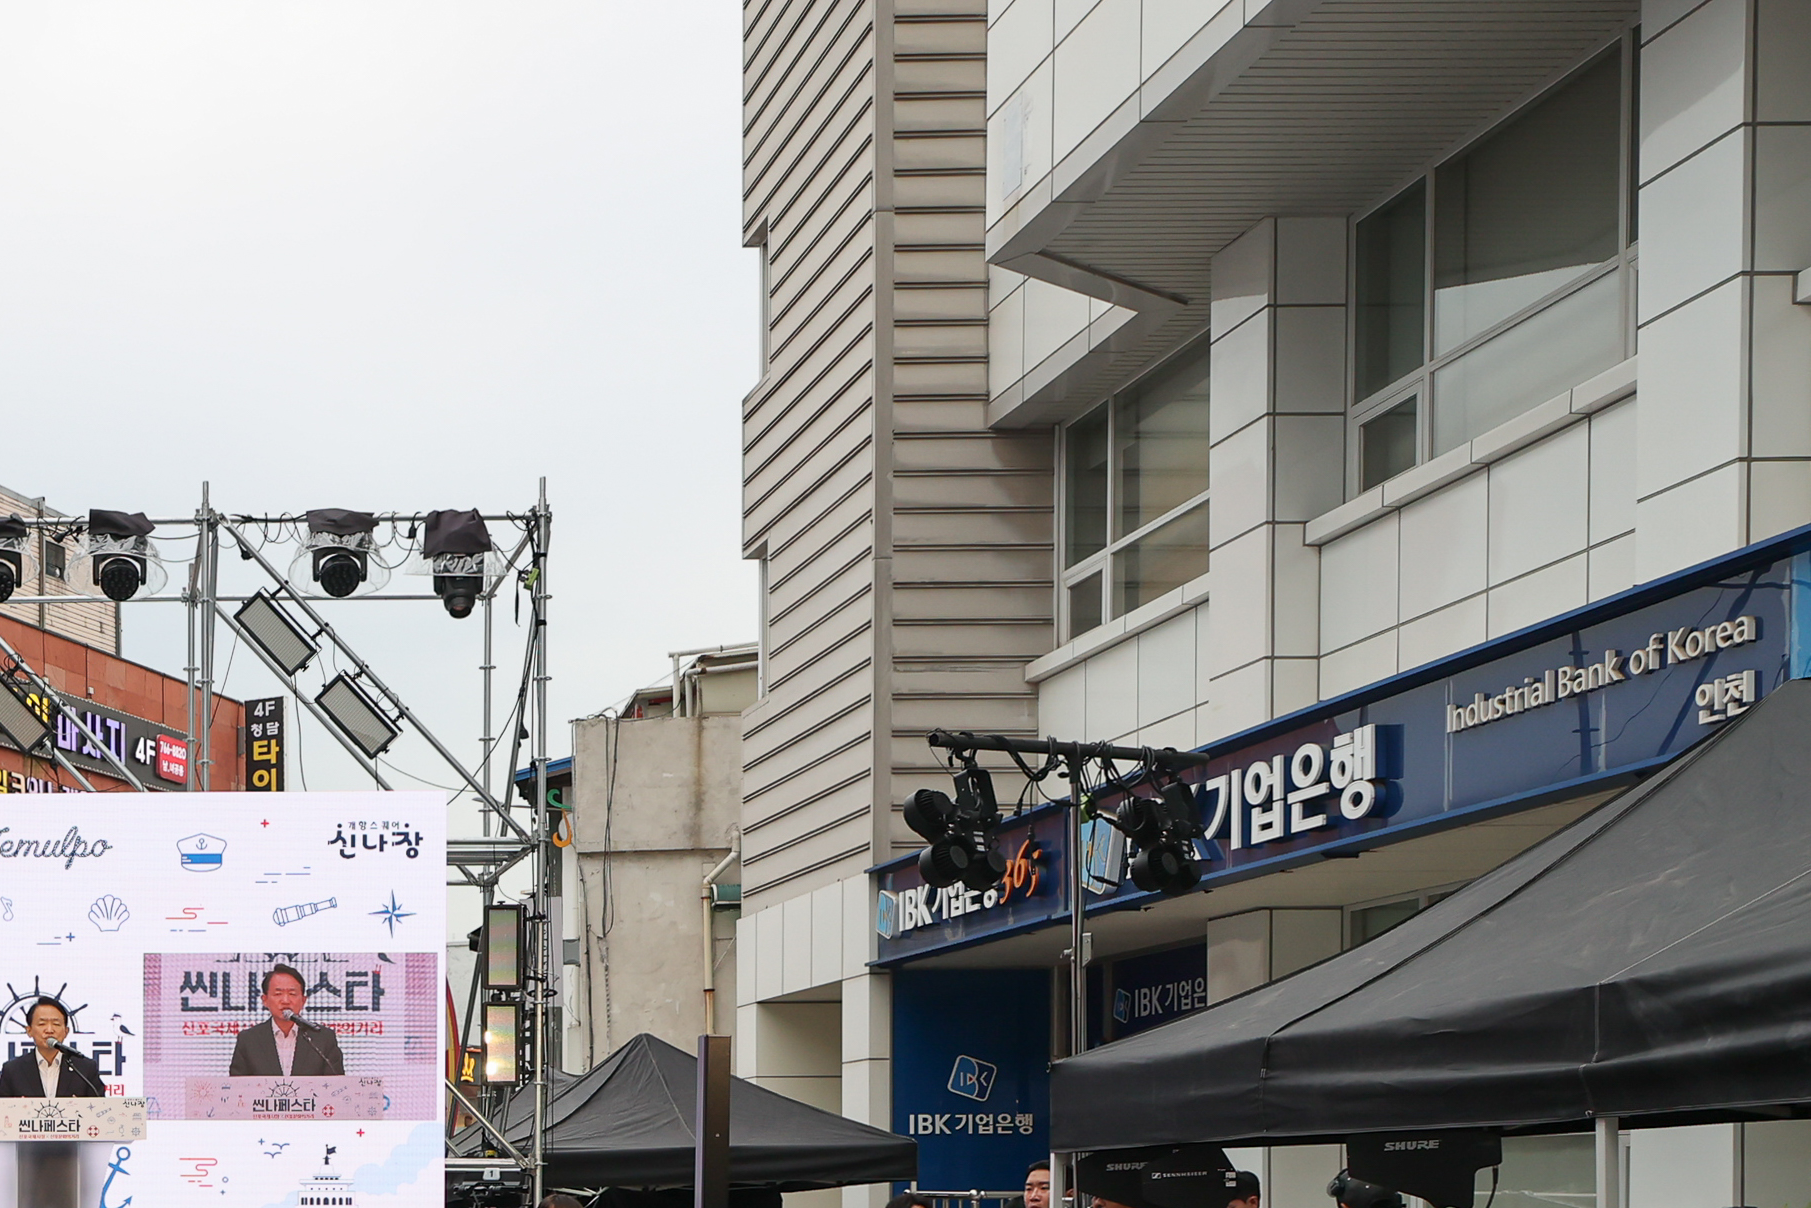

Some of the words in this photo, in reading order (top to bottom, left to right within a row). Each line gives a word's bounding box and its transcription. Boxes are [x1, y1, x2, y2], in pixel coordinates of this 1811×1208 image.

[1446, 668, 1556, 734] Industrial
[1557, 648, 1626, 700] Bank
[1629, 632, 1665, 677] of
[1666, 615, 1756, 665] Korea
[253, 701, 276, 717] 4F
[1694, 669, 1756, 726] 인천
[250, 721, 280, 738] 청담
[135, 736, 156, 765] 4F
[179, 970, 385, 1013] 씬나스타
[18, 1119, 81, 1133] 씬나페스타
[1383, 1139, 1441, 1151] SHURE
